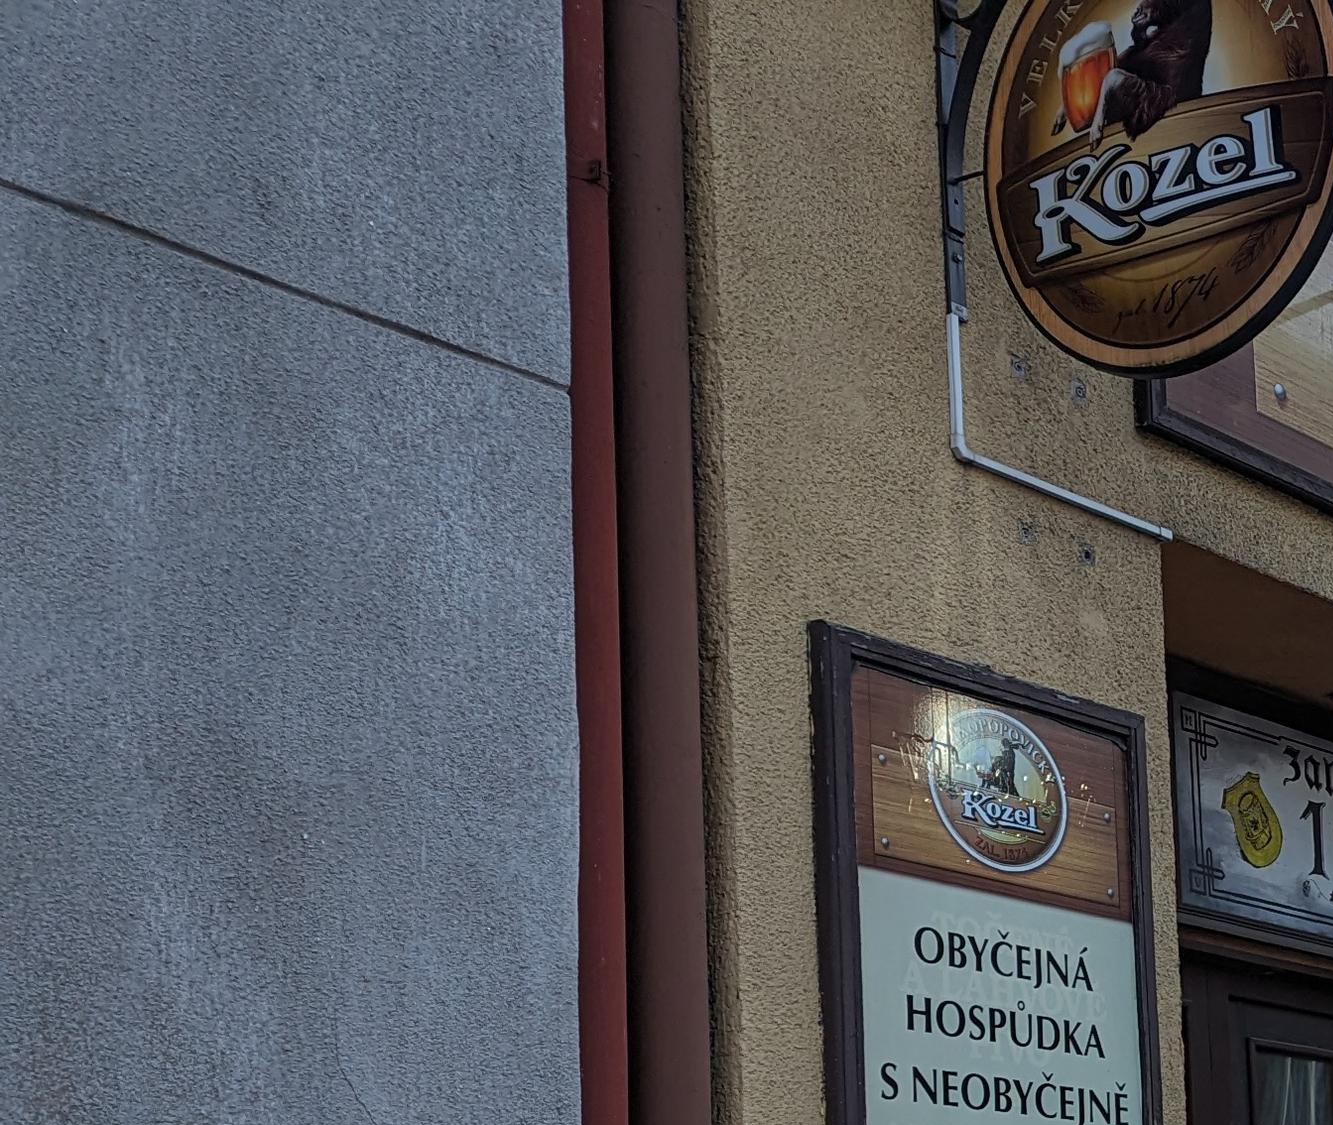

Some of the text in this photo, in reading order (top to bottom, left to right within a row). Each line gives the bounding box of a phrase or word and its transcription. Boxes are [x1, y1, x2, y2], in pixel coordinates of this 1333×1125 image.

[1030, 108, 1296, 262] Kozel
[1153, 267, 1219, 328] 1874
[961, 787, 1045, 834] Kozel
[914, 926, 1095, 992] OBYČEJNÁ
[906, 994, 1106, 1059] HOSPŮDKA
[880, 1062, 899, 1101] S
